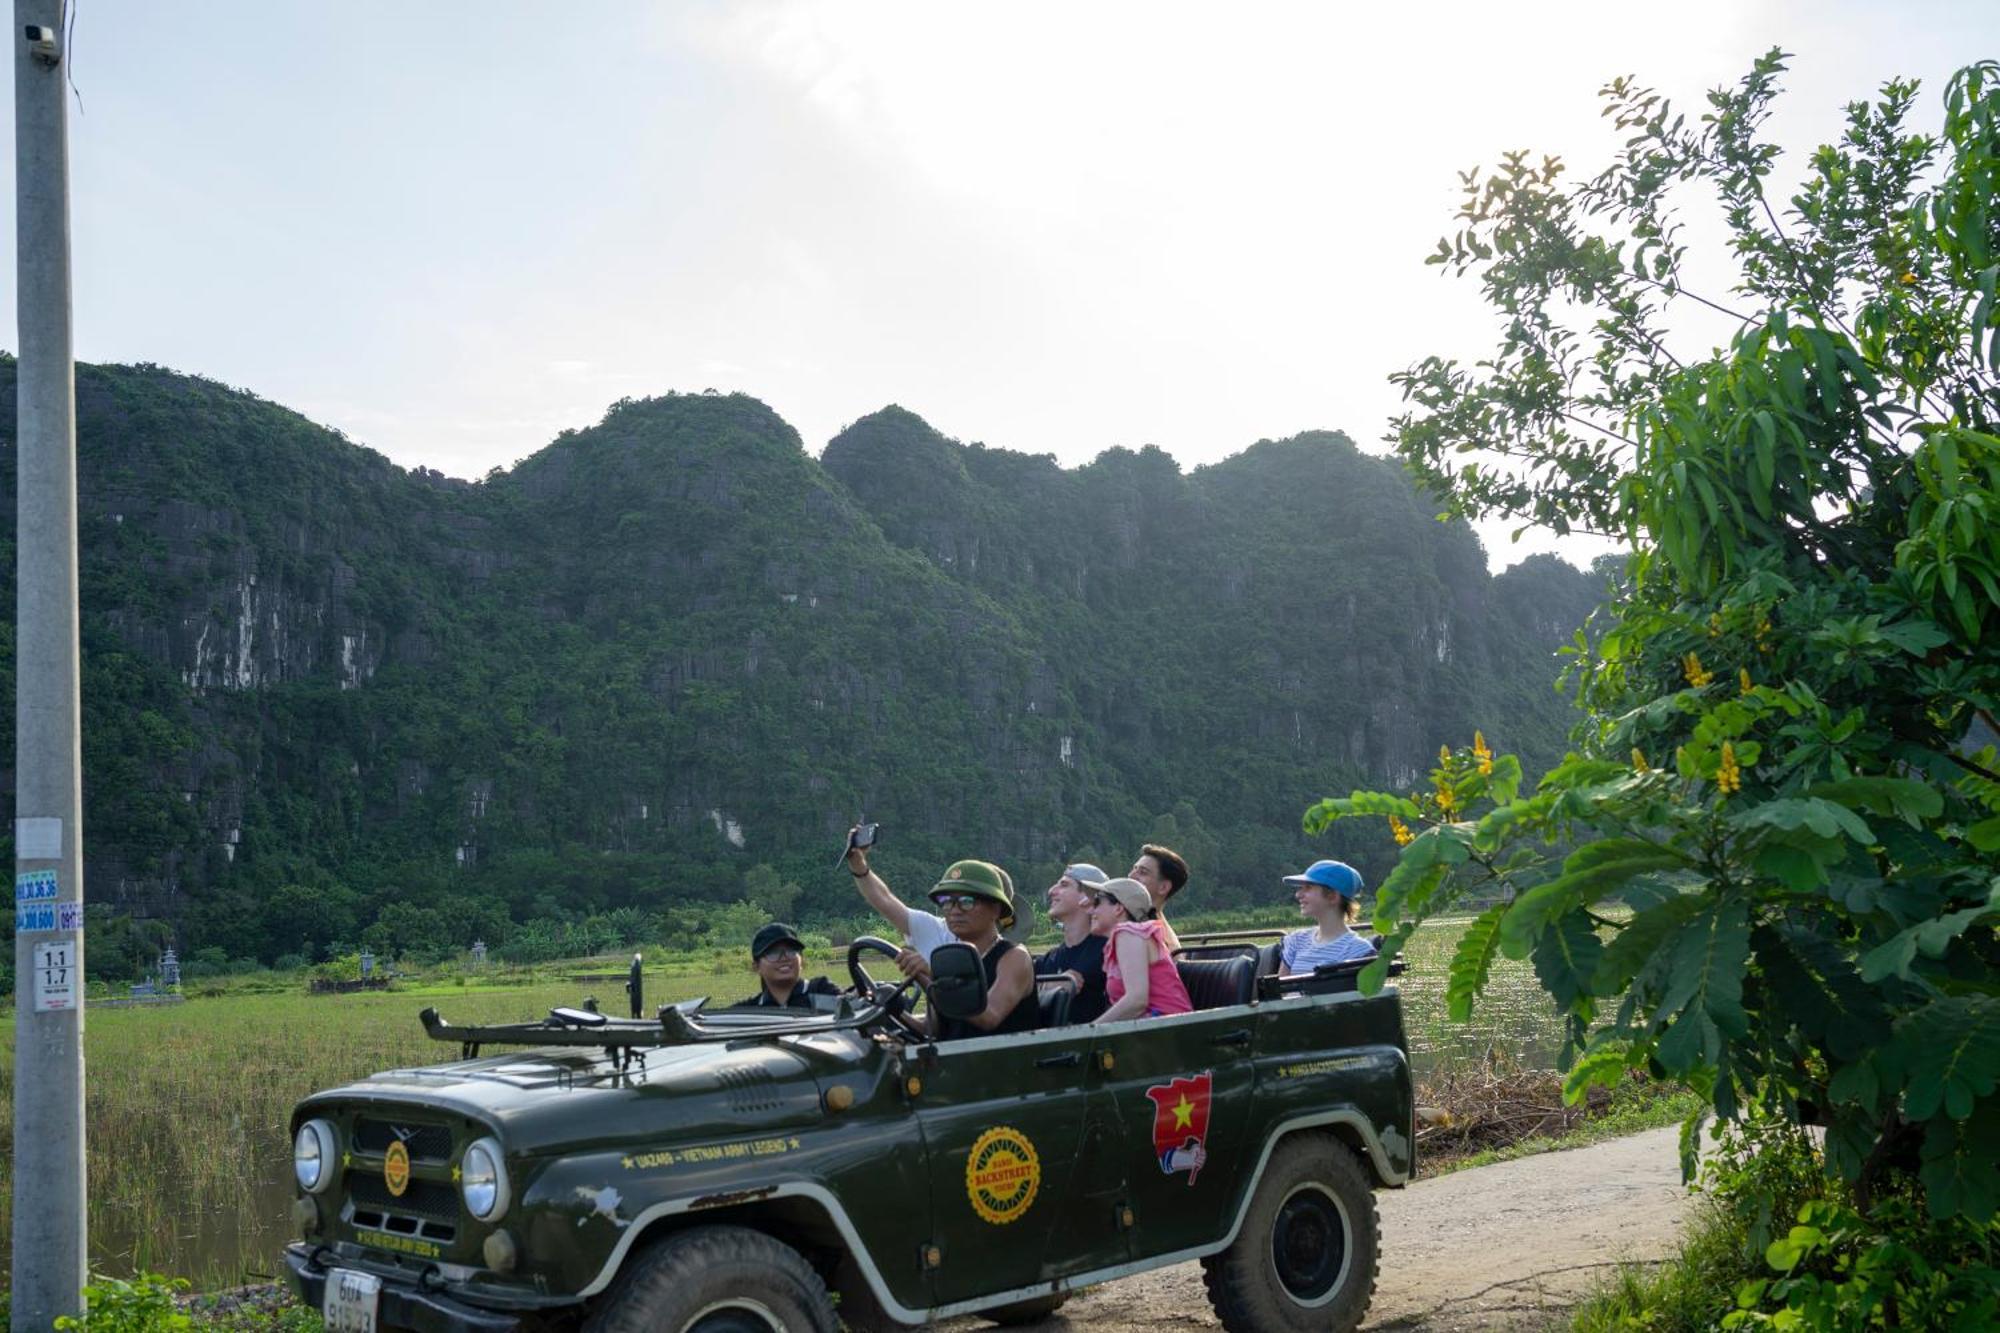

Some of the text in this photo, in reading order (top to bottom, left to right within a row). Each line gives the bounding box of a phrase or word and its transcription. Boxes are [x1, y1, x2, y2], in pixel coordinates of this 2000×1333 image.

[45, 951, 65, 966] 1.1
[45, 969, 66, 985] 1.7
[975, 1165, 1031, 1186] BACKSTREET
